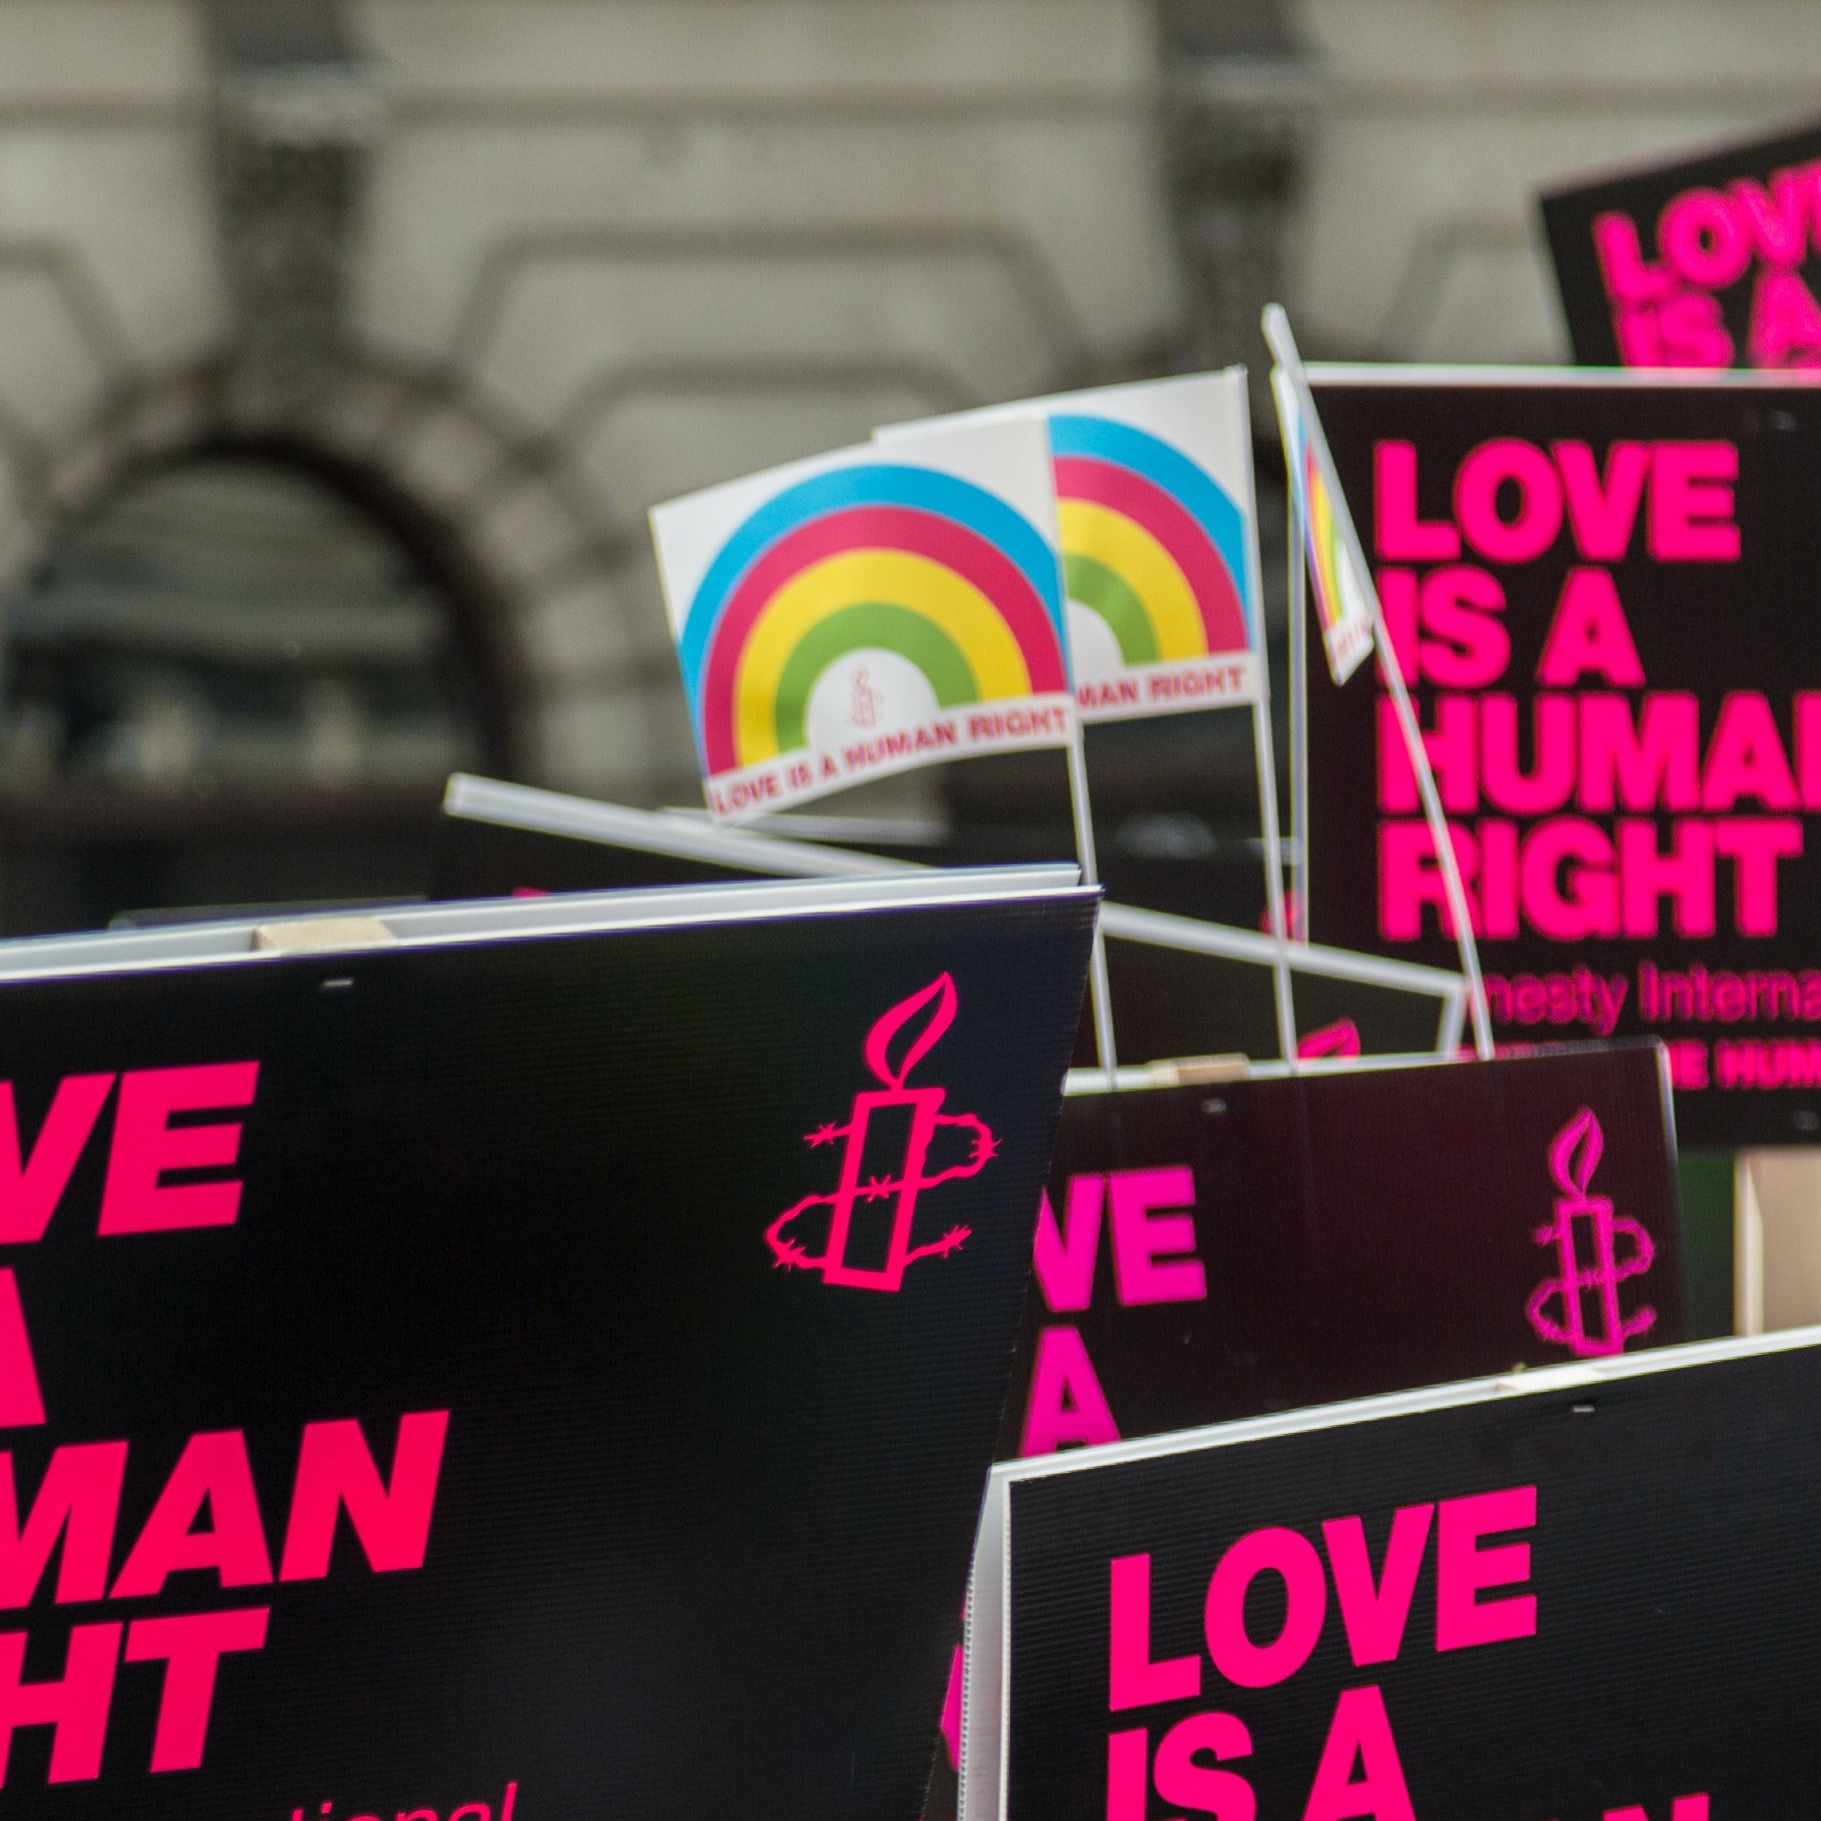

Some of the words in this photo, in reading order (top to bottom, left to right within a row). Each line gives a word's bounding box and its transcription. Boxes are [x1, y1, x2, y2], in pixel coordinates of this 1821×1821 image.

[1373, 438, 1741, 565] LOVE
[1077, 676, 1138, 709] MAN
[1148, 665, 1245, 700] RIGHT
[1375, 566, 1511, 690] IS
[1537, 566, 1647, 690] A
[711, 774, 779, 816] LOVE
[790, 765, 812, 790] IS
[821, 760, 838, 779] A
[845, 721, 957, 767] HUMAN
[969, 707, 1068, 739] RIGHT
[1378, 816, 1803, 942] RIGHT
[1479, 961, 1629, 1037] nesty
[1033, 1165, 1207, 1313] VE
[1019, 1324, 1122, 1459] A
[1109, 1485, 1537, 1712] LOVE
